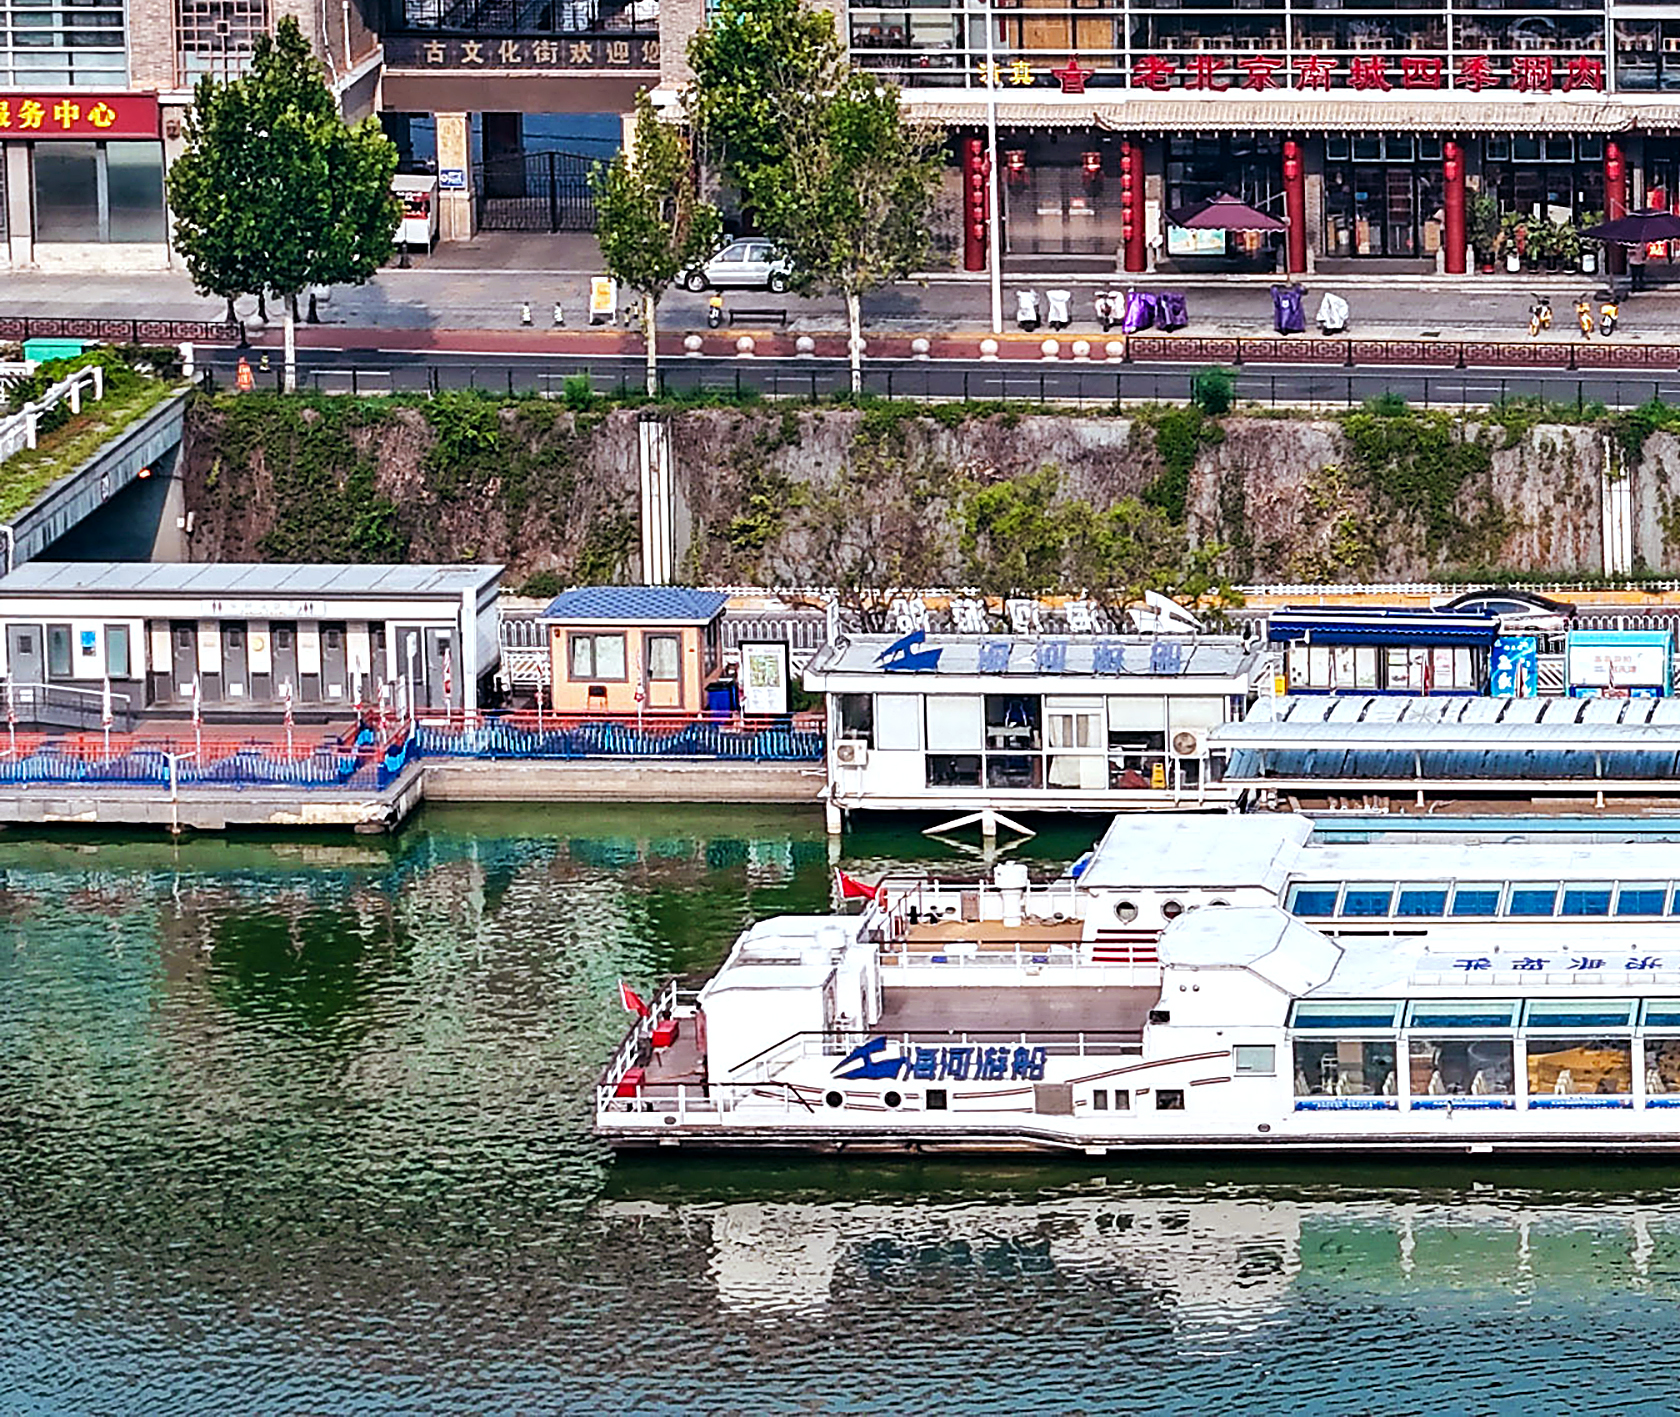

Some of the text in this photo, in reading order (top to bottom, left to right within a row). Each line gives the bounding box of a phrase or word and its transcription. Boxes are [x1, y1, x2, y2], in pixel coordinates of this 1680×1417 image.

[423, 40, 661, 64] 古文化街欢迎您
[1132, 54, 1603, 93] 老北京南城四季涮肉
[902, 1046, 1047, 1081] 海河游船
